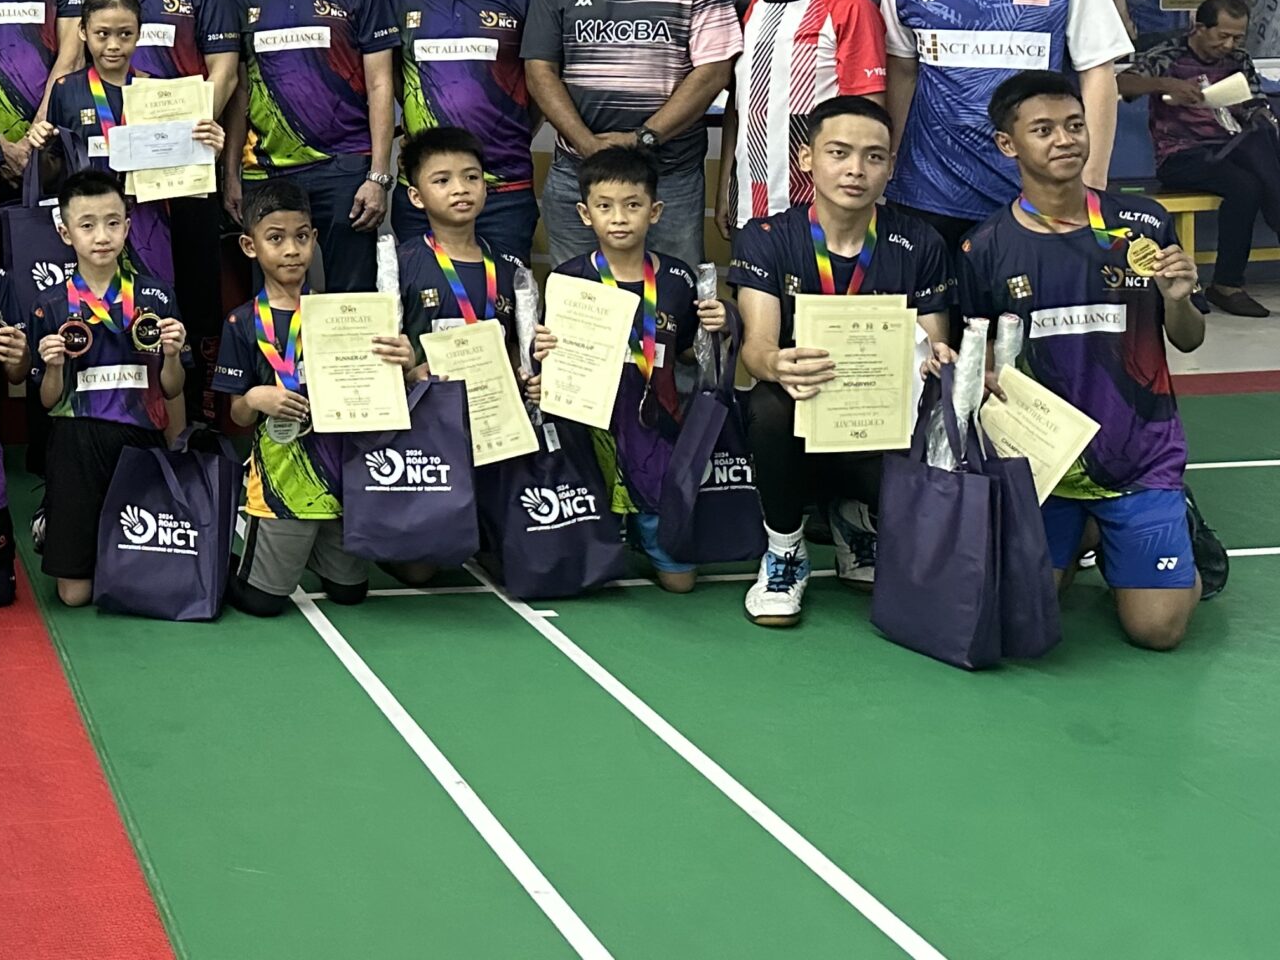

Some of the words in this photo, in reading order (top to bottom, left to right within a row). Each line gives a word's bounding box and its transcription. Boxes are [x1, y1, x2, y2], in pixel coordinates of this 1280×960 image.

[498, 18, 517, 28] NCT
[575, 20, 671, 43] KKCBA
[259, 35, 277, 45] NCT
[278, 32, 323, 44] ALLIANCE
[421, 45, 440, 54] NCT
[442, 44, 491, 54] ALLIANCE
[940, 43, 969, 54] NCT
[972, 43, 1046, 58] ALLIANCE
[1119, 210, 1163, 228] ULTRON
[751, 266, 769, 278] NCT
[1126, 277, 1150, 287] NCT
[142, 288, 168, 304] ULTRON
[325, 316, 372, 324] CERTIFICATE
[1033, 316, 1057, 328] NCT
[1061, 312, 1120, 326] ALLIANCE
[228, 368, 243, 377] NCT
[406, 464, 450, 484] NCT
[715, 466, 752, 484] NCT
[556, 484, 569, 492] 2024
[559, 489, 575, 500] ROAD
[576, 488, 588, 496] TO
[561, 495, 596, 519] NCT
[159, 520, 178, 528] ROAD
[159, 529, 198, 547] NCT
